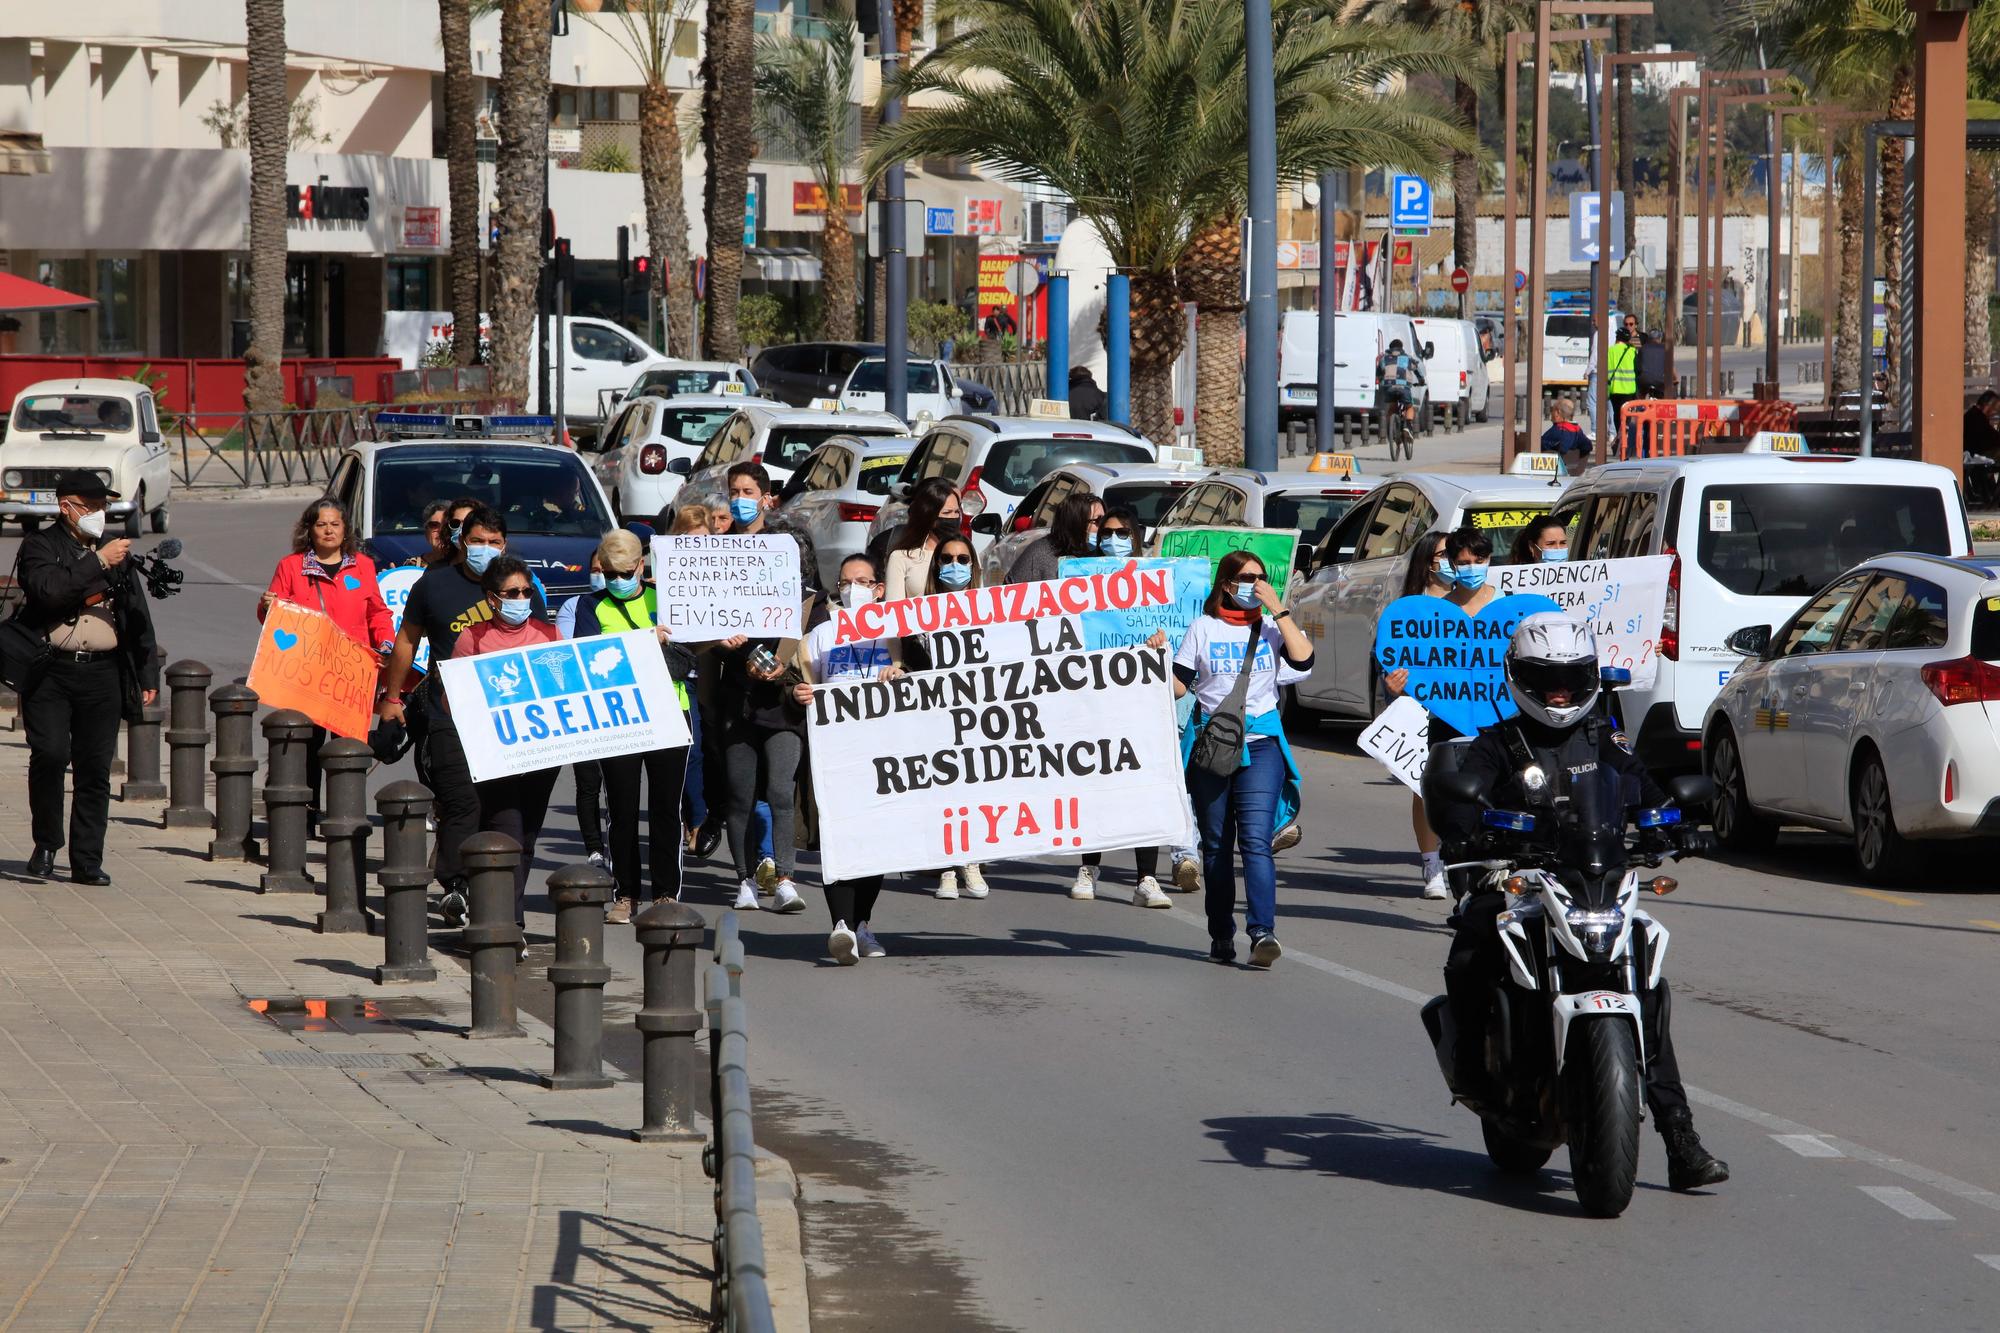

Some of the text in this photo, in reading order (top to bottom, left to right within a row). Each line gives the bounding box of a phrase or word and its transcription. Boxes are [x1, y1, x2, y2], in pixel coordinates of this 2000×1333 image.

[1401, 180, 1422, 210] P
[727, 384, 743, 393] TAXI
[823, 400, 840, 410] TAXI
[1042, 403, 1060, 415] TAXI
[1772, 435, 1799, 451] TAXI
[1329, 456, 1351, 469] TAXI
[1532, 457, 1557, 470] TAXI
[669, 556, 765, 567] FORMENTERA
[1501, 563, 1609, 589] RESIDENCIA
[668, 586, 716, 597] CEUTA
[835, 560, 1169, 645] ACTUALIZACIÓN
[762, 607, 793, 629] ???
[1127, 614, 1190, 627] SALARIAL
[932, 616, 1083, 669] DE LA
[303, 635, 355, 682] VAMOS
[262, 652, 313, 687] NOS
[813, 643, 1166, 726] INDEMNIZACIÓN
[490, 687, 650, 746] U.S.E.I.R.I
[950, 701, 1045, 746] POR
[536, 742, 575, 754] SANITARIOS
[576, 738, 588, 746] POR
[569, 749, 584, 757] POR
[584, 747, 593, 755] LA
[593, 743, 630, 755] RESIDENCIA
[630, 742, 639, 750] EN
[640, 739, 656, 748] IBIZA
[872, 737, 1141, 795] RESIDENCIA
[1594, 1000, 1628, 1010] 112
